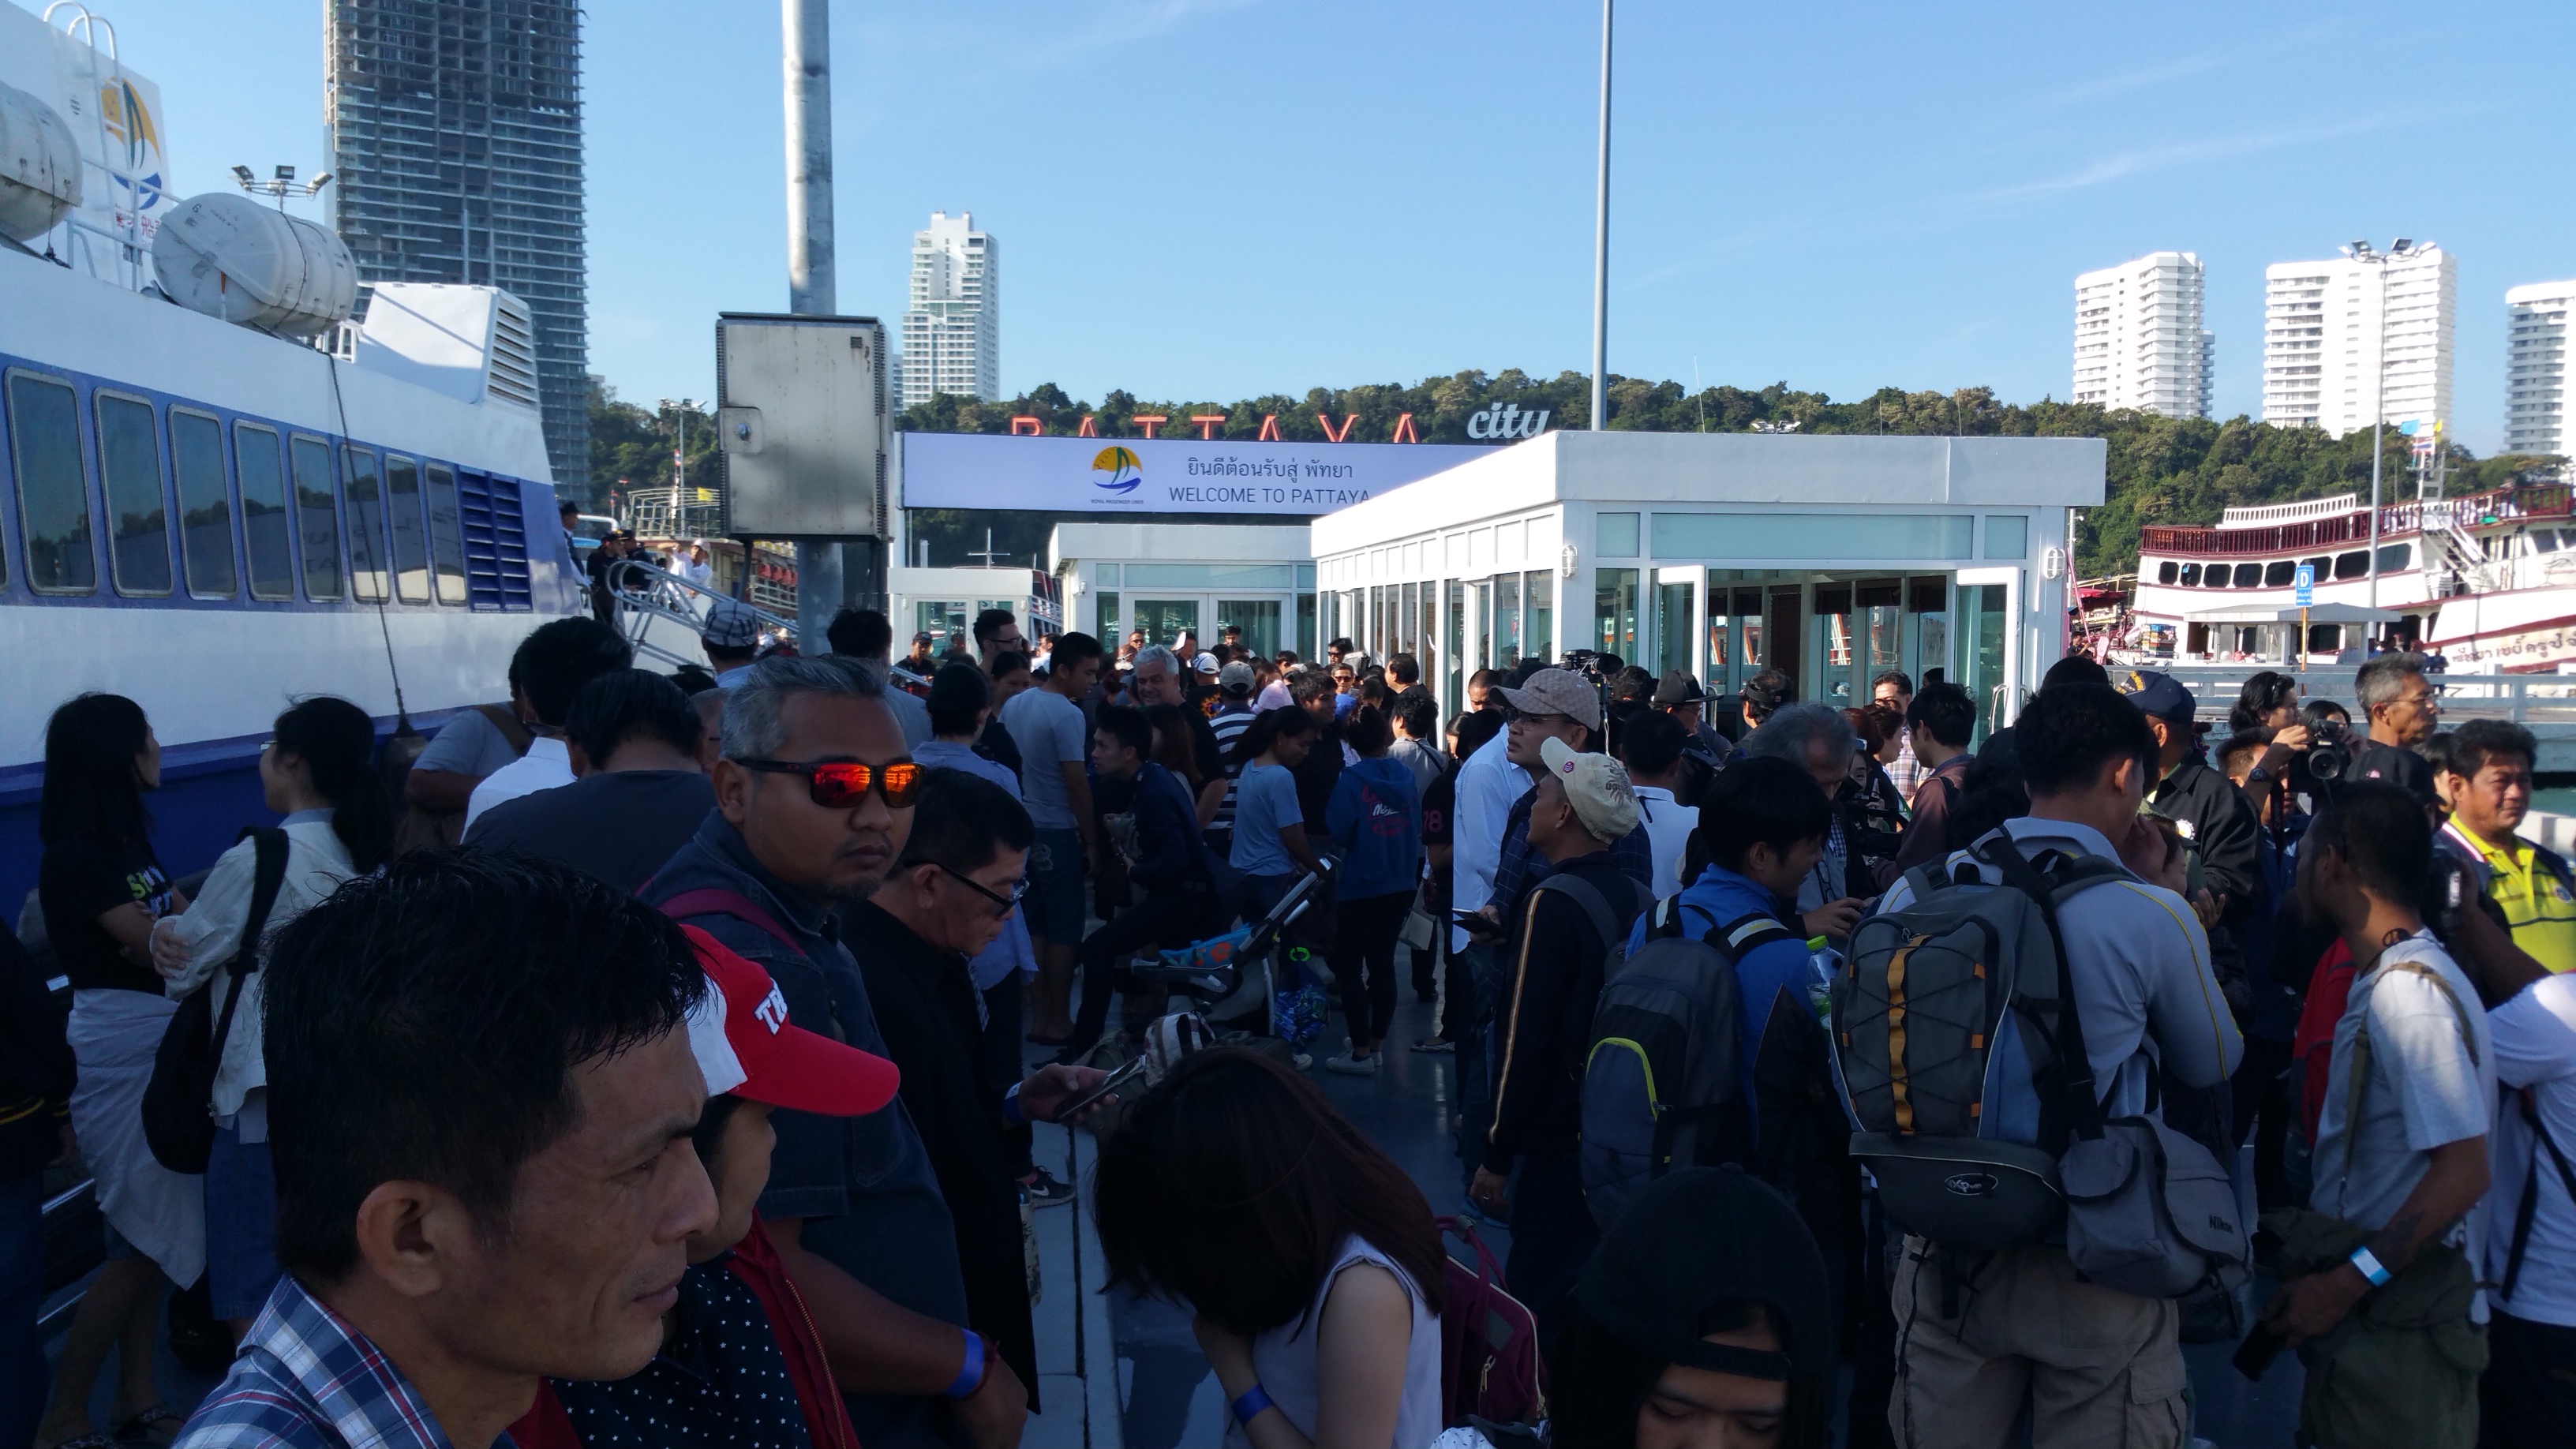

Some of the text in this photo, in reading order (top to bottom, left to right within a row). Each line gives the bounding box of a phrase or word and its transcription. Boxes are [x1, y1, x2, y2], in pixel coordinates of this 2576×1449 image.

[1466, 401, 1551, 439] city
[1188, 456, 1353, 484] ยินดีต้อนรับสู่ พัทยา
[1169, 487, 1369, 504] WELCOME TO PATTAYA
[2300, 571, 2309, 588] D
